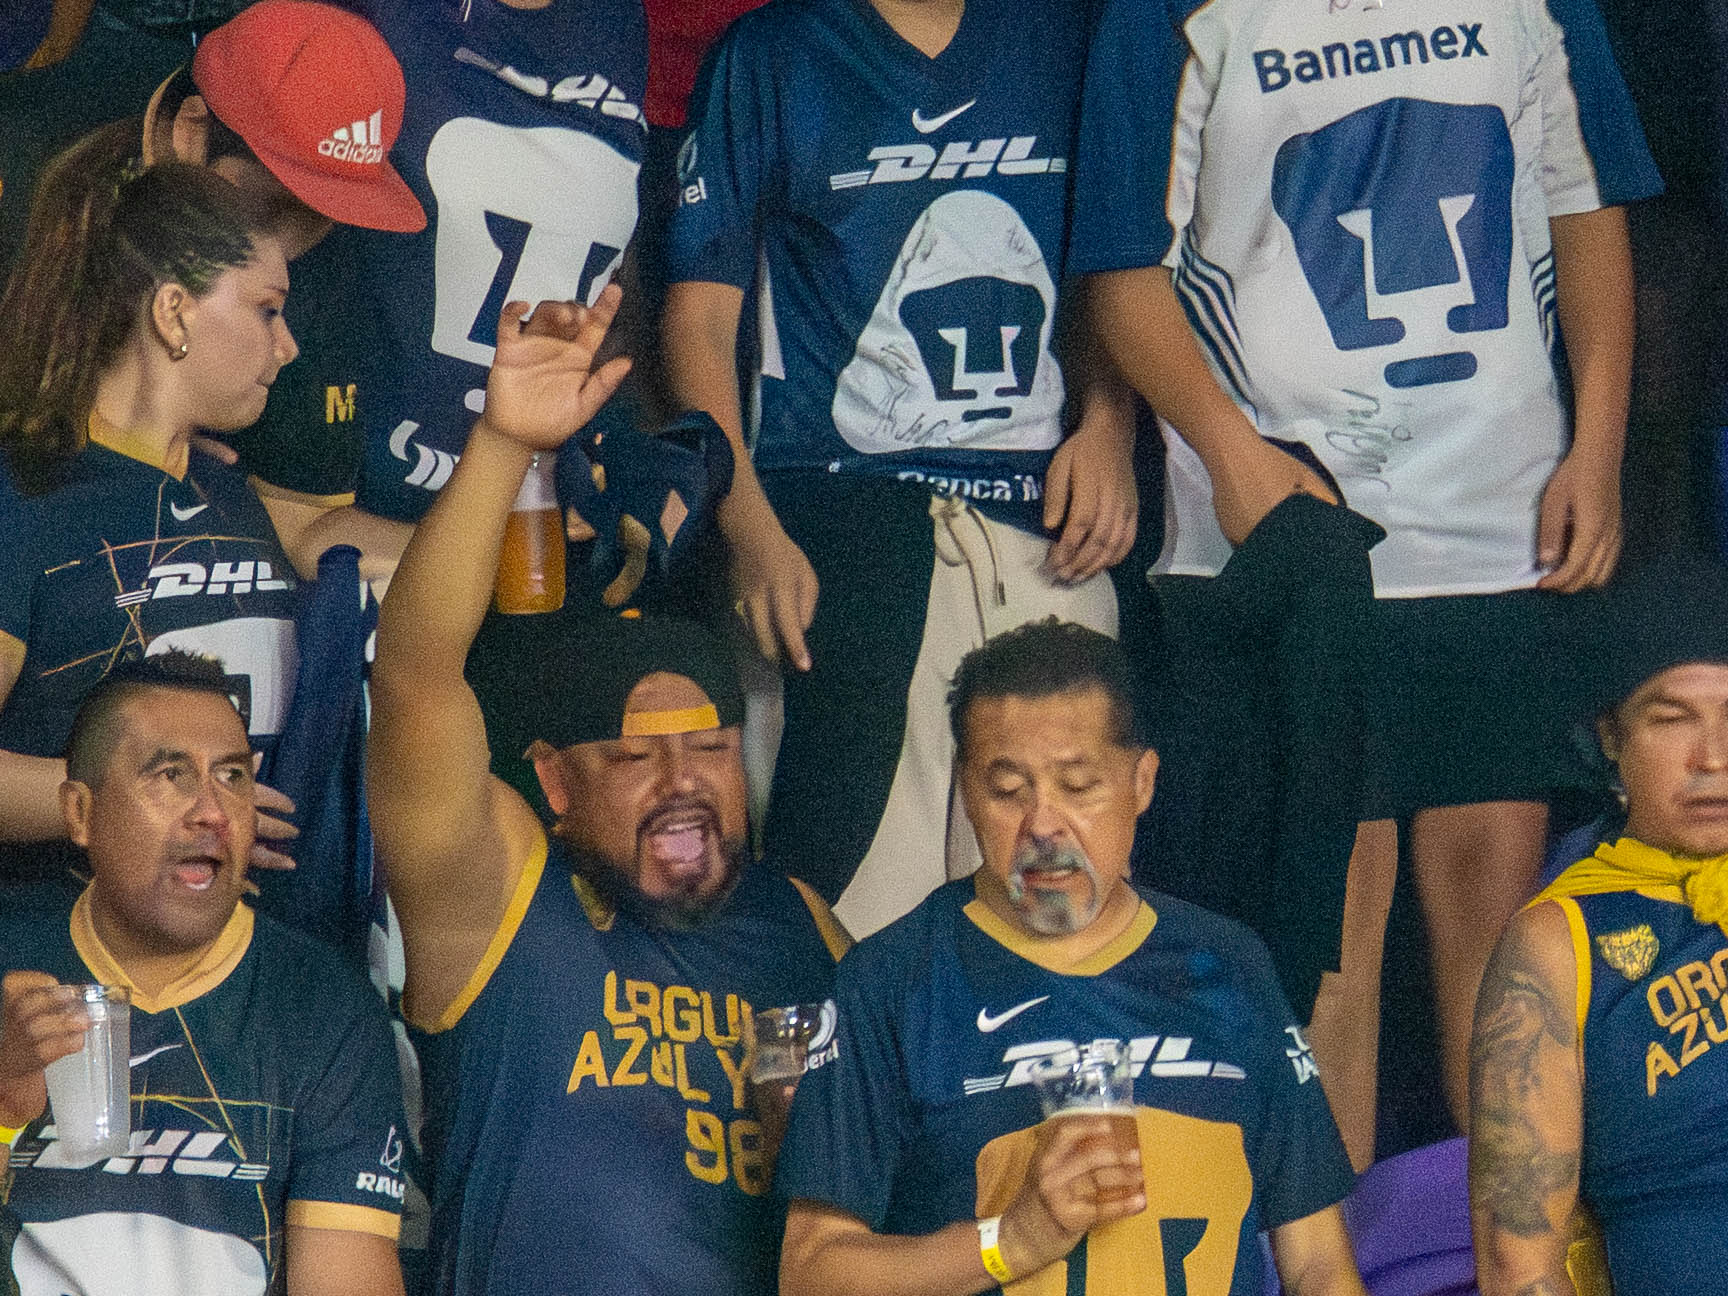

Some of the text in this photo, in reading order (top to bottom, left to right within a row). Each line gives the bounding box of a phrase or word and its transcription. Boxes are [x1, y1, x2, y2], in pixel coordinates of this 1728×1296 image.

[1253, 22, 1490, 94] Banamex
[868, 136, 1050, 184] DHL
[148, 560, 290, 601] DHL
